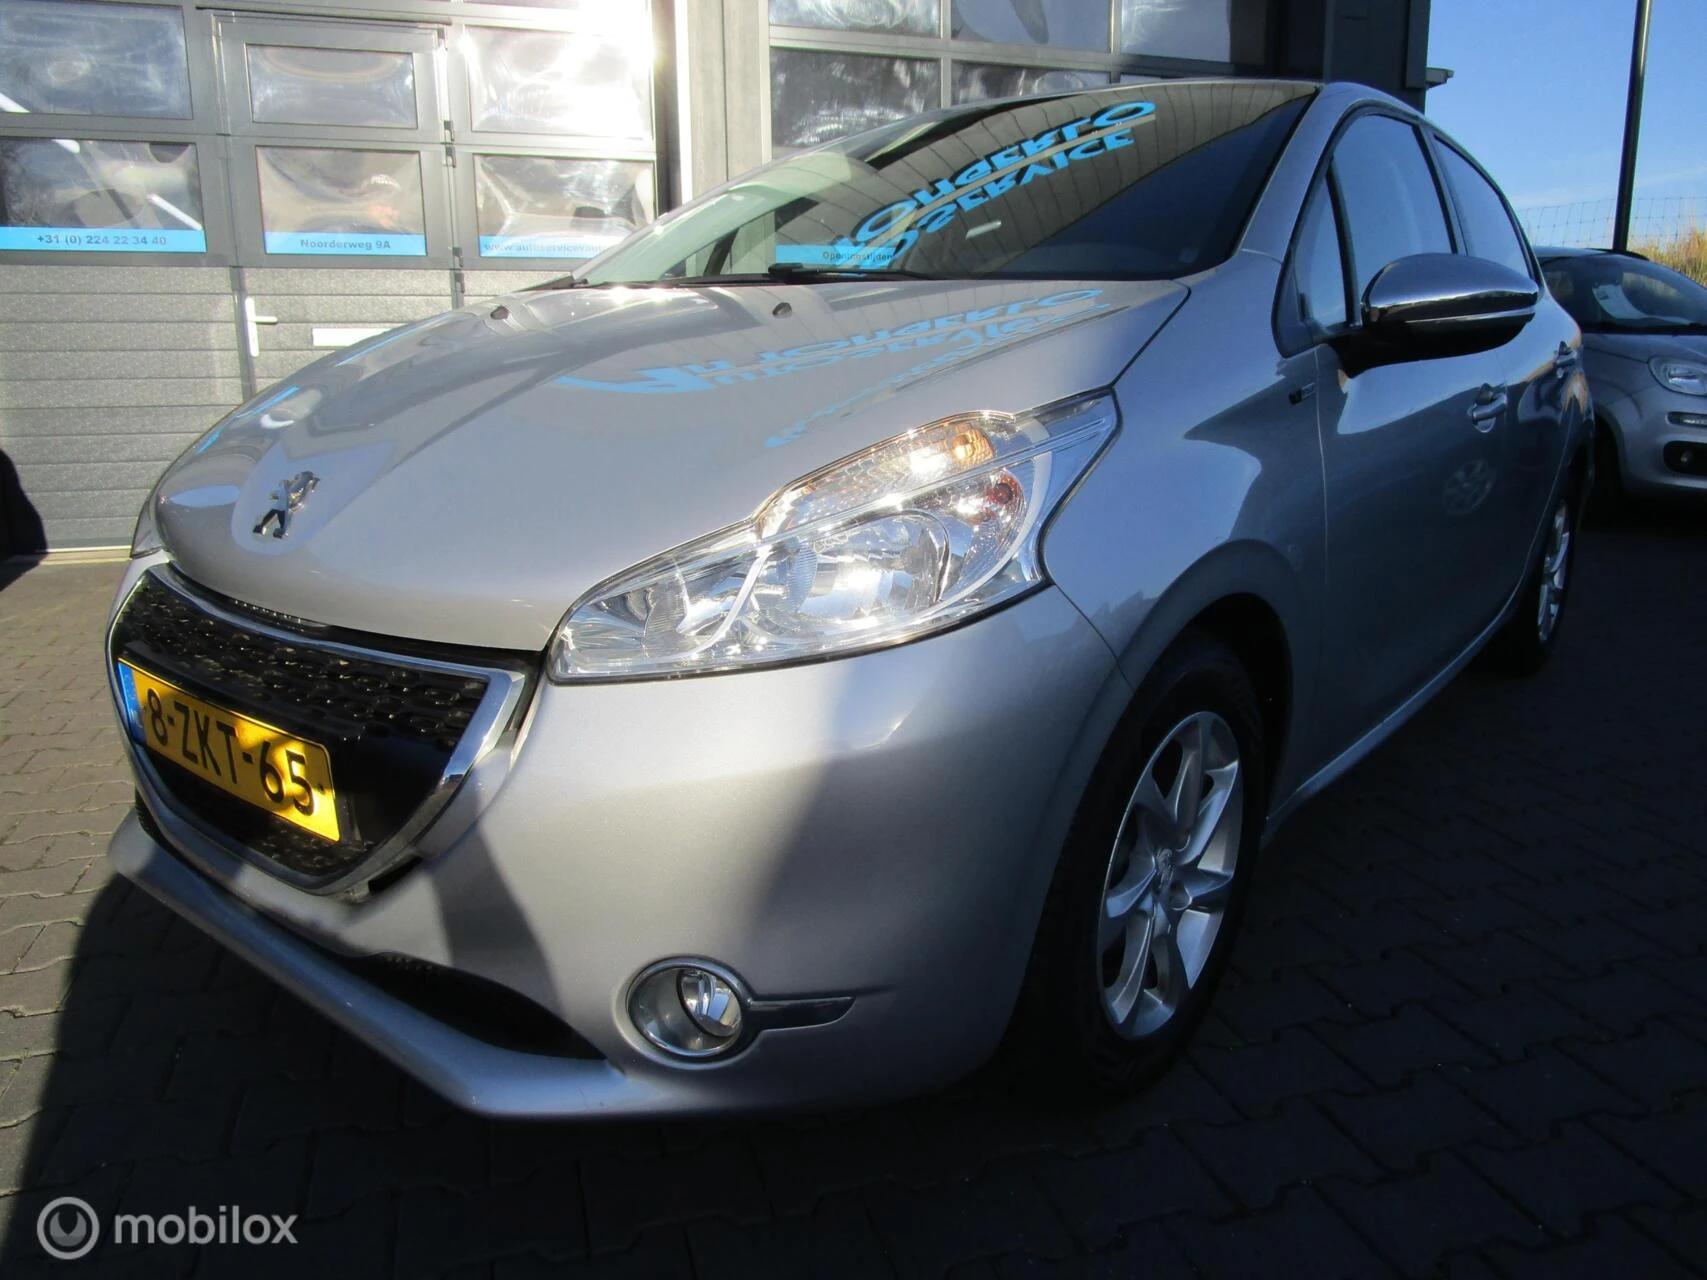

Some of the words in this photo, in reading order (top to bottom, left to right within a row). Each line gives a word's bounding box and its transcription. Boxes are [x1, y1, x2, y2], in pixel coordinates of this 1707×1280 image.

[36, 234, 60, 244] +31
[65, 234, 82, 245] (0)
[86, 235, 109, 245] 224
[113, 235, 129, 245] 22
[133, 235, 148, 245] 34
[151, 235, 167, 245] 40
[300, 239, 373, 250] Noorderweg
[375, 240, 391, 249] 9A
[147, 687, 316, 817] 8-ZKT-65
